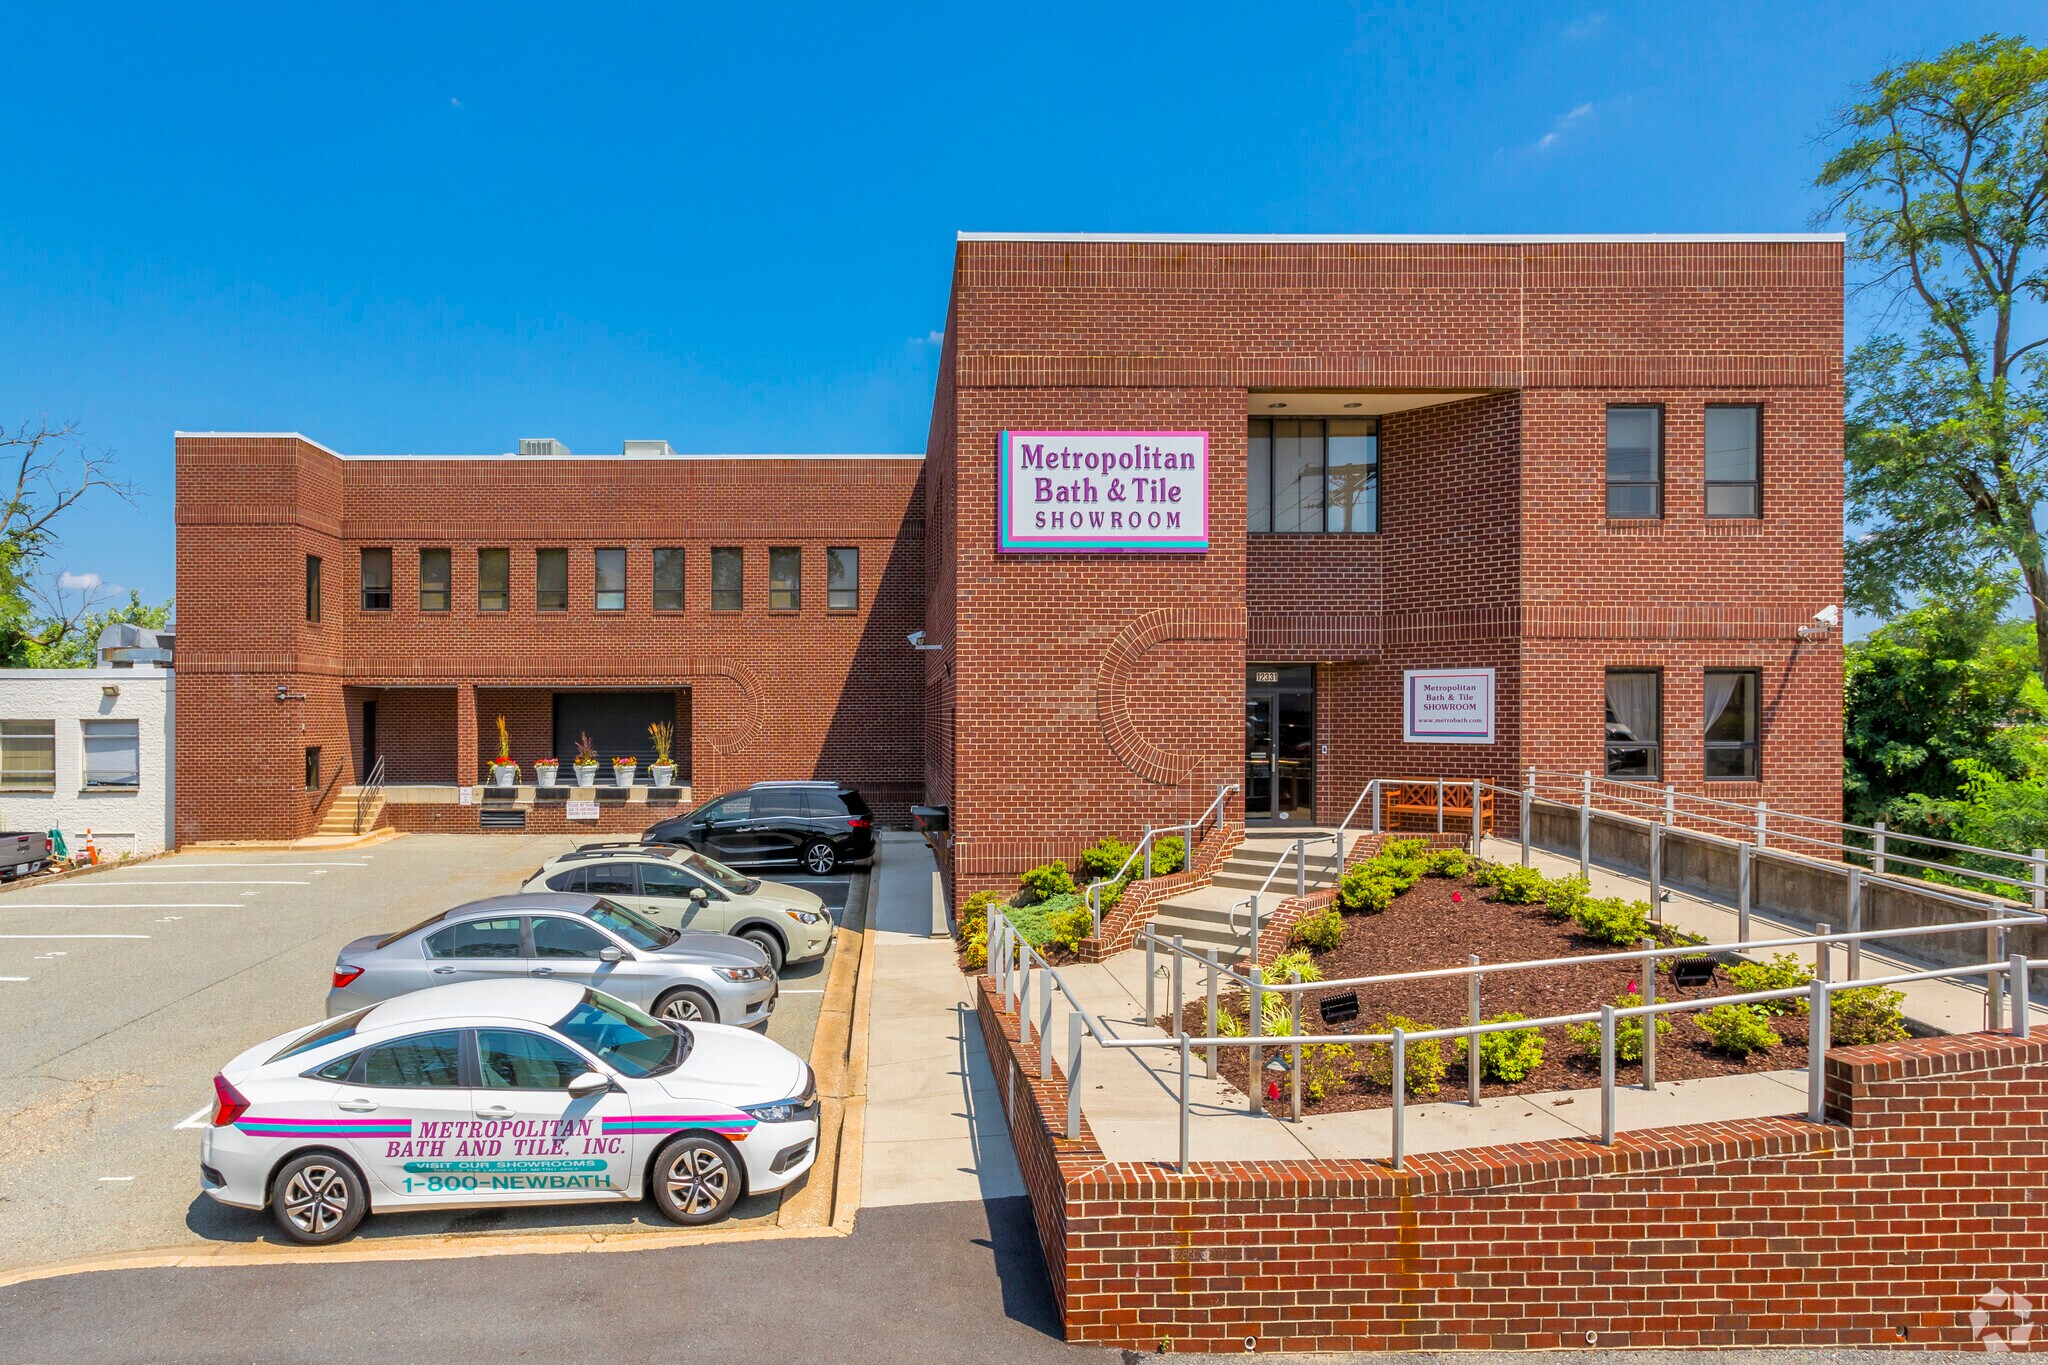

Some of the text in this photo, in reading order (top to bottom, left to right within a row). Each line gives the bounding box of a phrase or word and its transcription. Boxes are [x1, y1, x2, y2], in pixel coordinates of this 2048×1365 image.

[1021, 444, 1196, 475] Metropolitan
[1035, 477, 1182, 502] Bath & Tile
[1035, 511, 1181, 529] SHOWROOM
[1256, 672, 1278, 682] 12331
[1423, 684, 1476, 692] Metropolitan
[417, 1119, 594, 1139] METROPOLITAN
[385, 1137, 626, 1158] BATH AND TILE, INC.
[496, 1160, 596, 1168] SHOWROOMS
[402, 1174, 611, 1193] 1-800-NEWBATH
